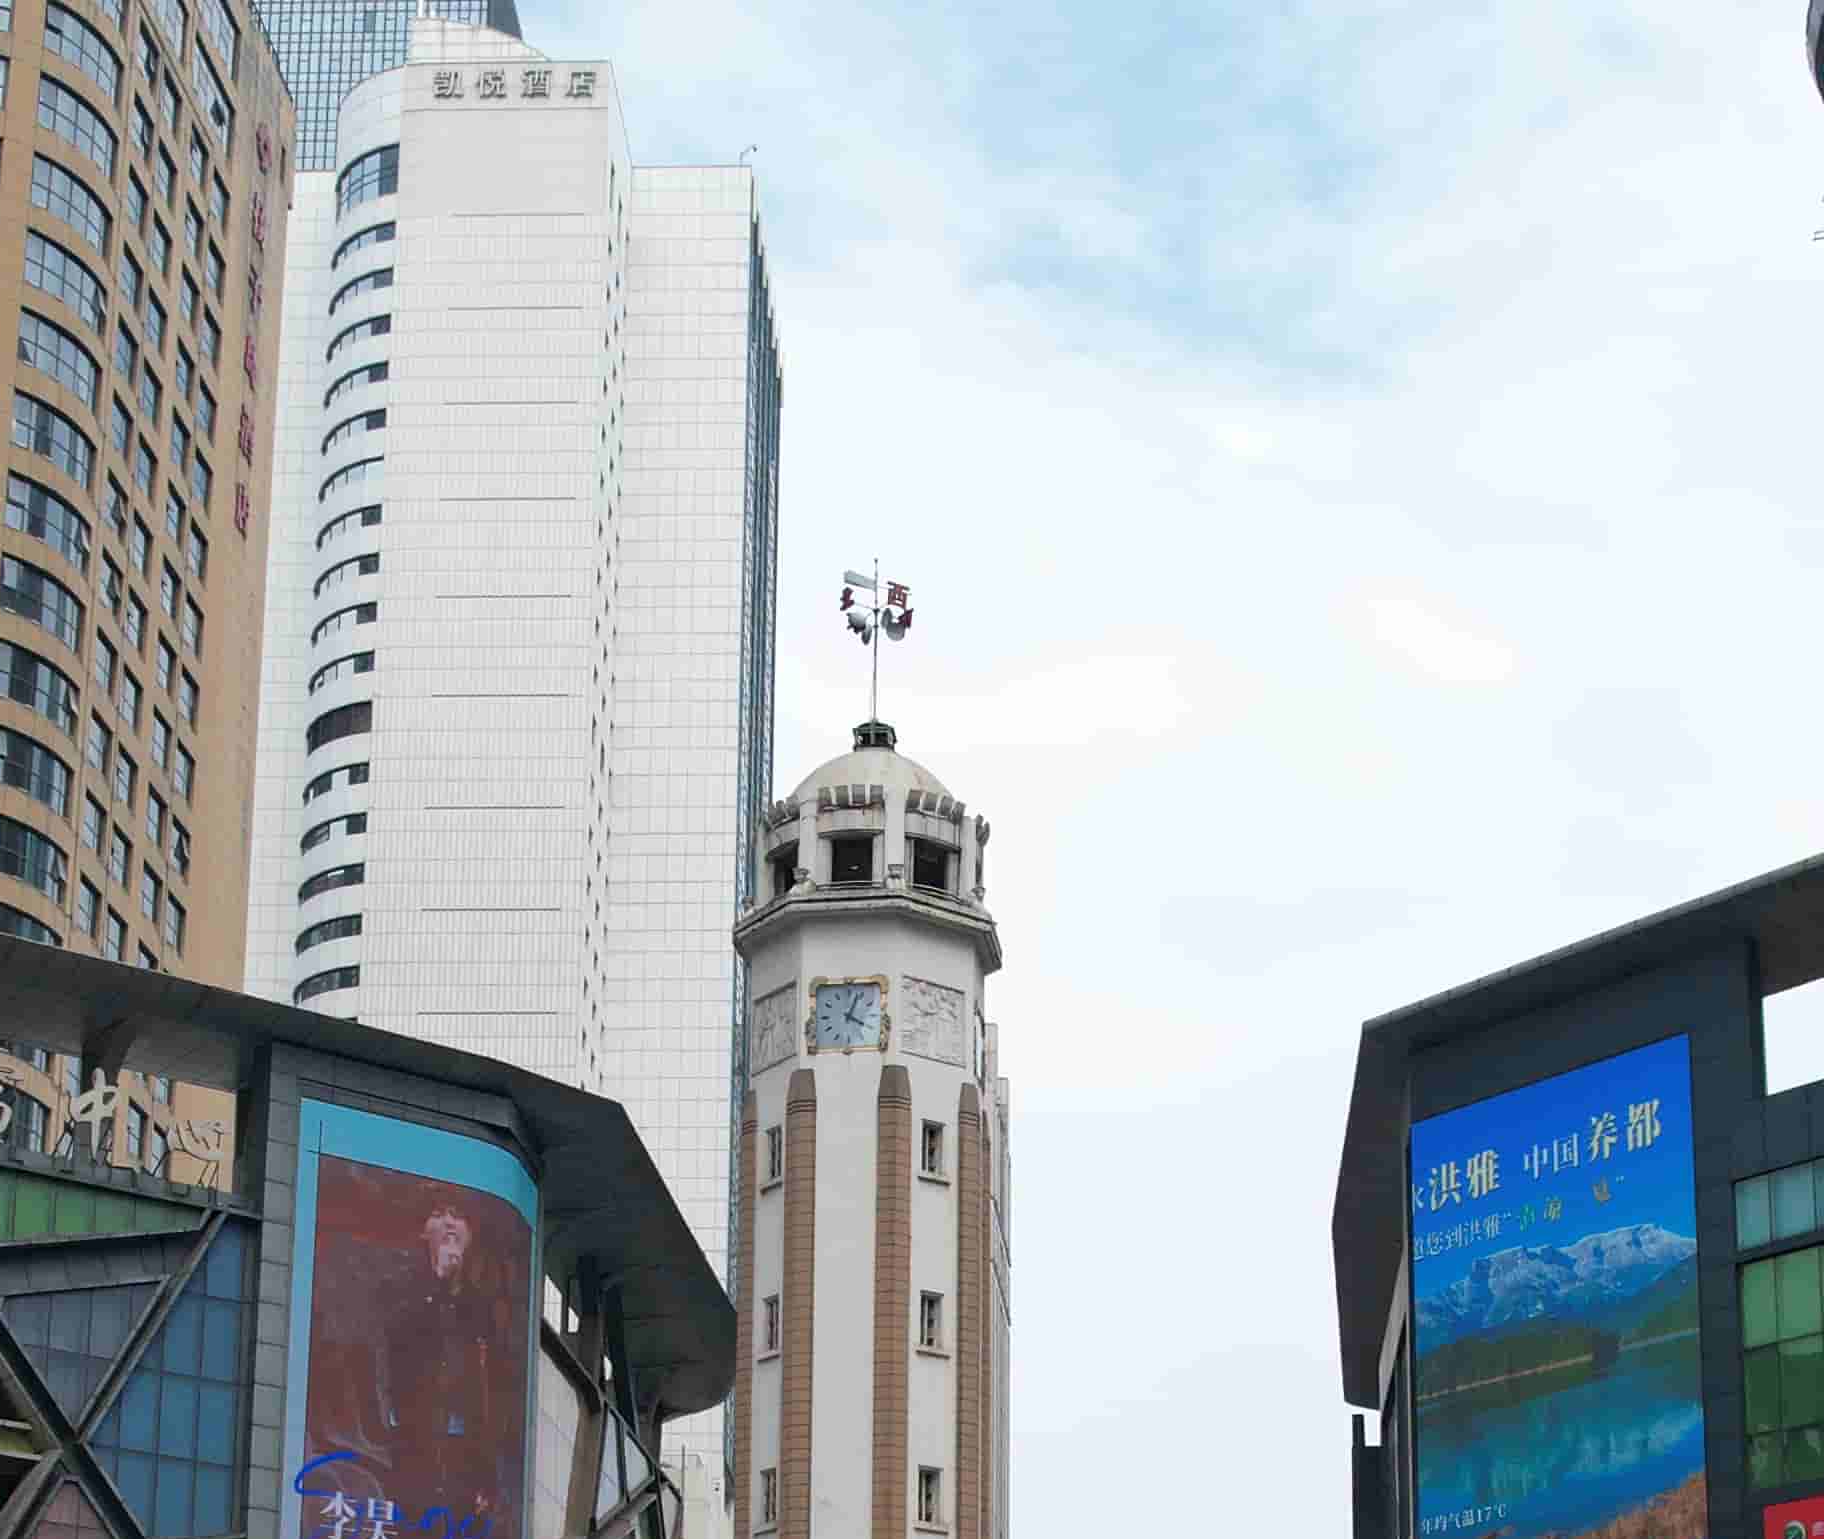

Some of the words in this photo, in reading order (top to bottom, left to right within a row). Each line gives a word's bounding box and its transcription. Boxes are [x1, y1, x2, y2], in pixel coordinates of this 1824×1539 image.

[432, 70, 596, 99] 凯悦酒店
[1523, 1098, 1662, 1180] 中国养都
